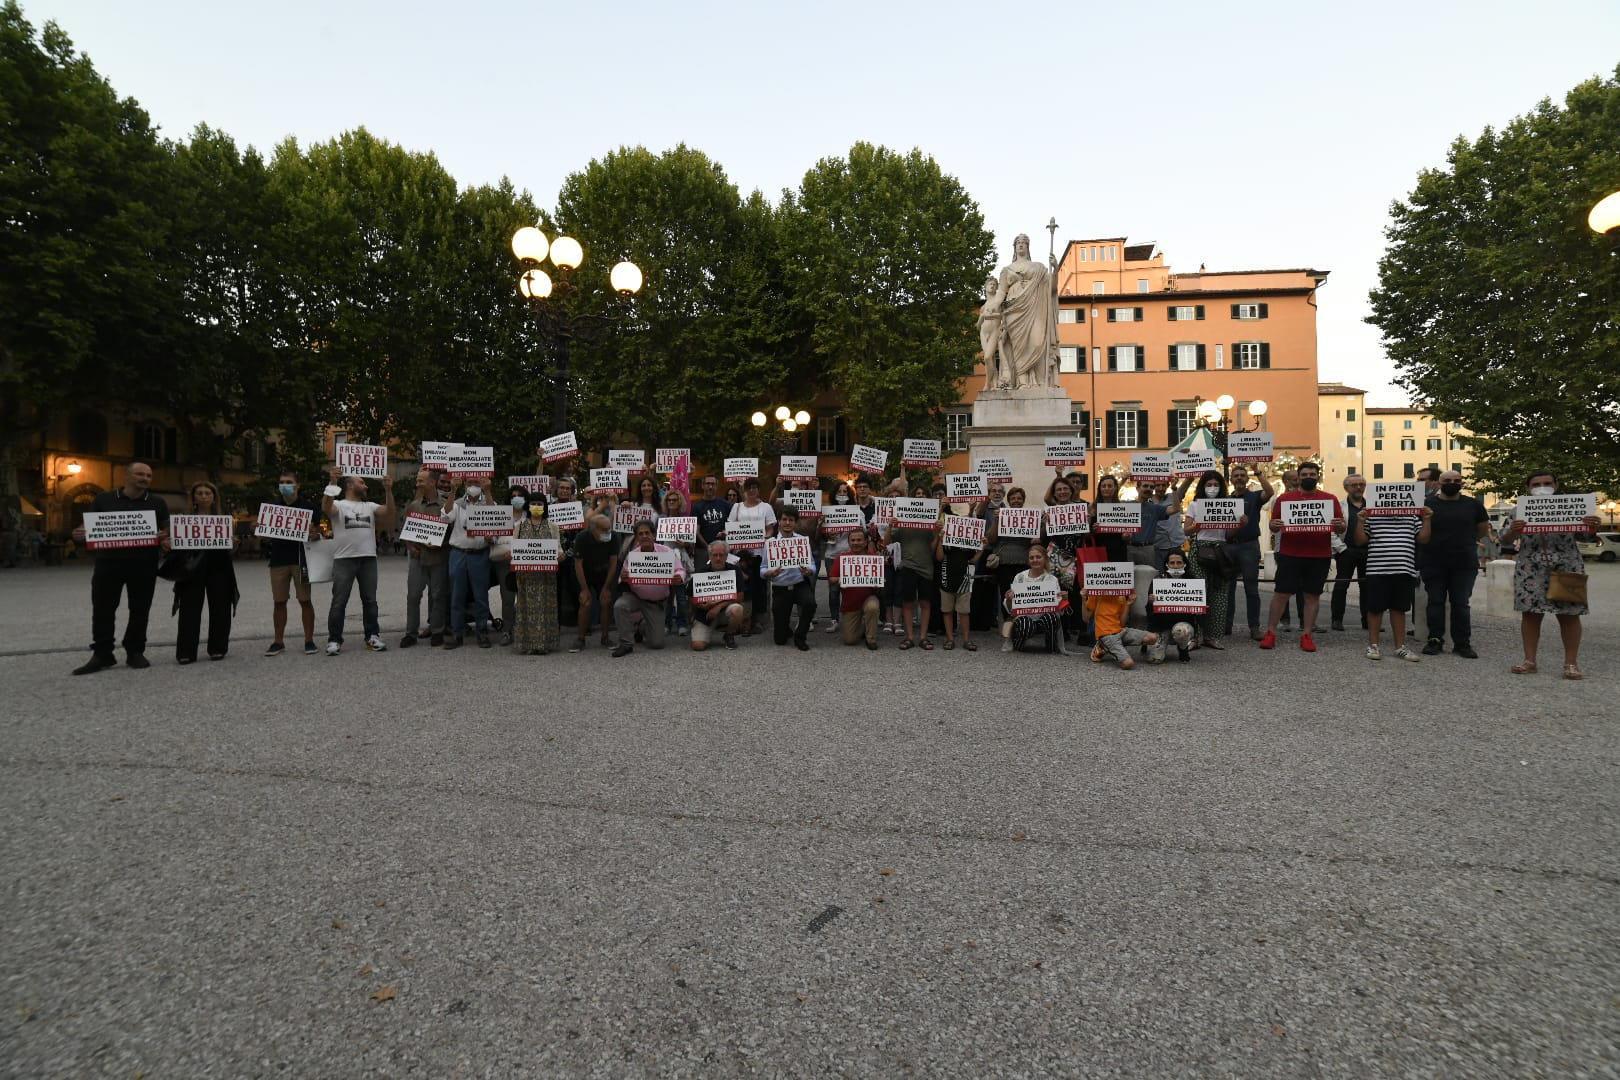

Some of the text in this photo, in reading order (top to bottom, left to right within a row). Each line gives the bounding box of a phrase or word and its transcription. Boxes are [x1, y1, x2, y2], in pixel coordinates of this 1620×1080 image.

[340, 447, 384, 455] #RESTIAMO
[340, 454, 384, 468] LIBERI
[351, 467, 384, 476] PENSARE
[263, 506, 310, 518] #RESTIAMO
[1048, 506, 1085, 514] #RESTIAMO
[260, 514, 308, 531] LIBERI
[948, 518, 984, 527] #RESTIAMO
[1001, 517, 1038, 528] LIBERI
[1048, 512, 1088, 526] LIBERI
[174, 526, 229, 538] LIBERI
[270, 528, 305, 538] PENSARE
[946, 524, 983, 539] LIBERI
[769, 538, 807, 547] #RESTIAMO
[769, 547, 809, 560] LIBERI
[780, 558, 808, 566] PENSARE
[843, 565, 882, 576] LIBERI
